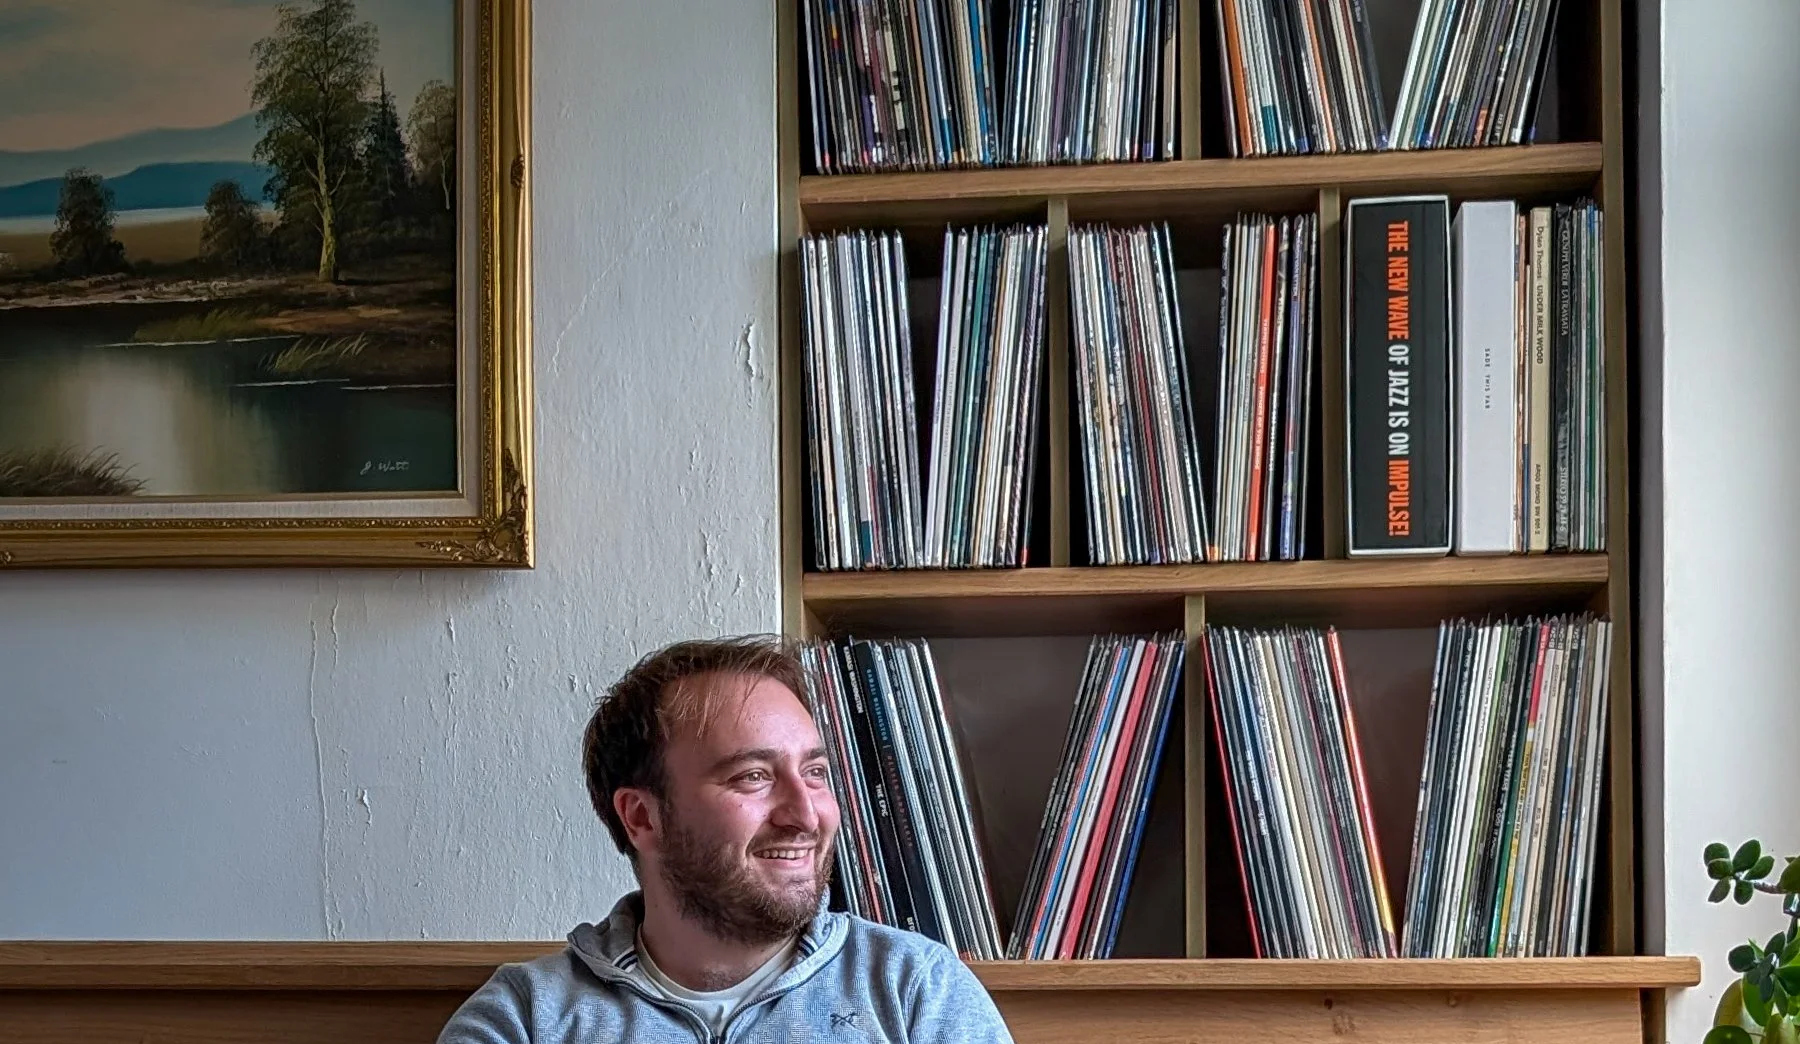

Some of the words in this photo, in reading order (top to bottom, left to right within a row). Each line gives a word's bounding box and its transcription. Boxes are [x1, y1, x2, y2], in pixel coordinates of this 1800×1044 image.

[1388, 220, 1409, 252] THE
[1536, 226, 1544, 248] Dylan
[1388, 256, 1409, 292] NEW
[1536, 285, 1544, 314] UNDER
[1388, 295, 1409, 340] WAVE
[1388, 344, 1409, 365] OF
[1536, 337, 1544, 365] WOOD
[1388, 369, 1409, 407] JAZZ
[1388, 411, 1409, 428] IS
[1388, 432, 1409, 456] ON
[1388, 459, 1409, 537] IMPULSE!
[875, 784, 884, 798] THE
[879, 799, 888, 817] EPIC
